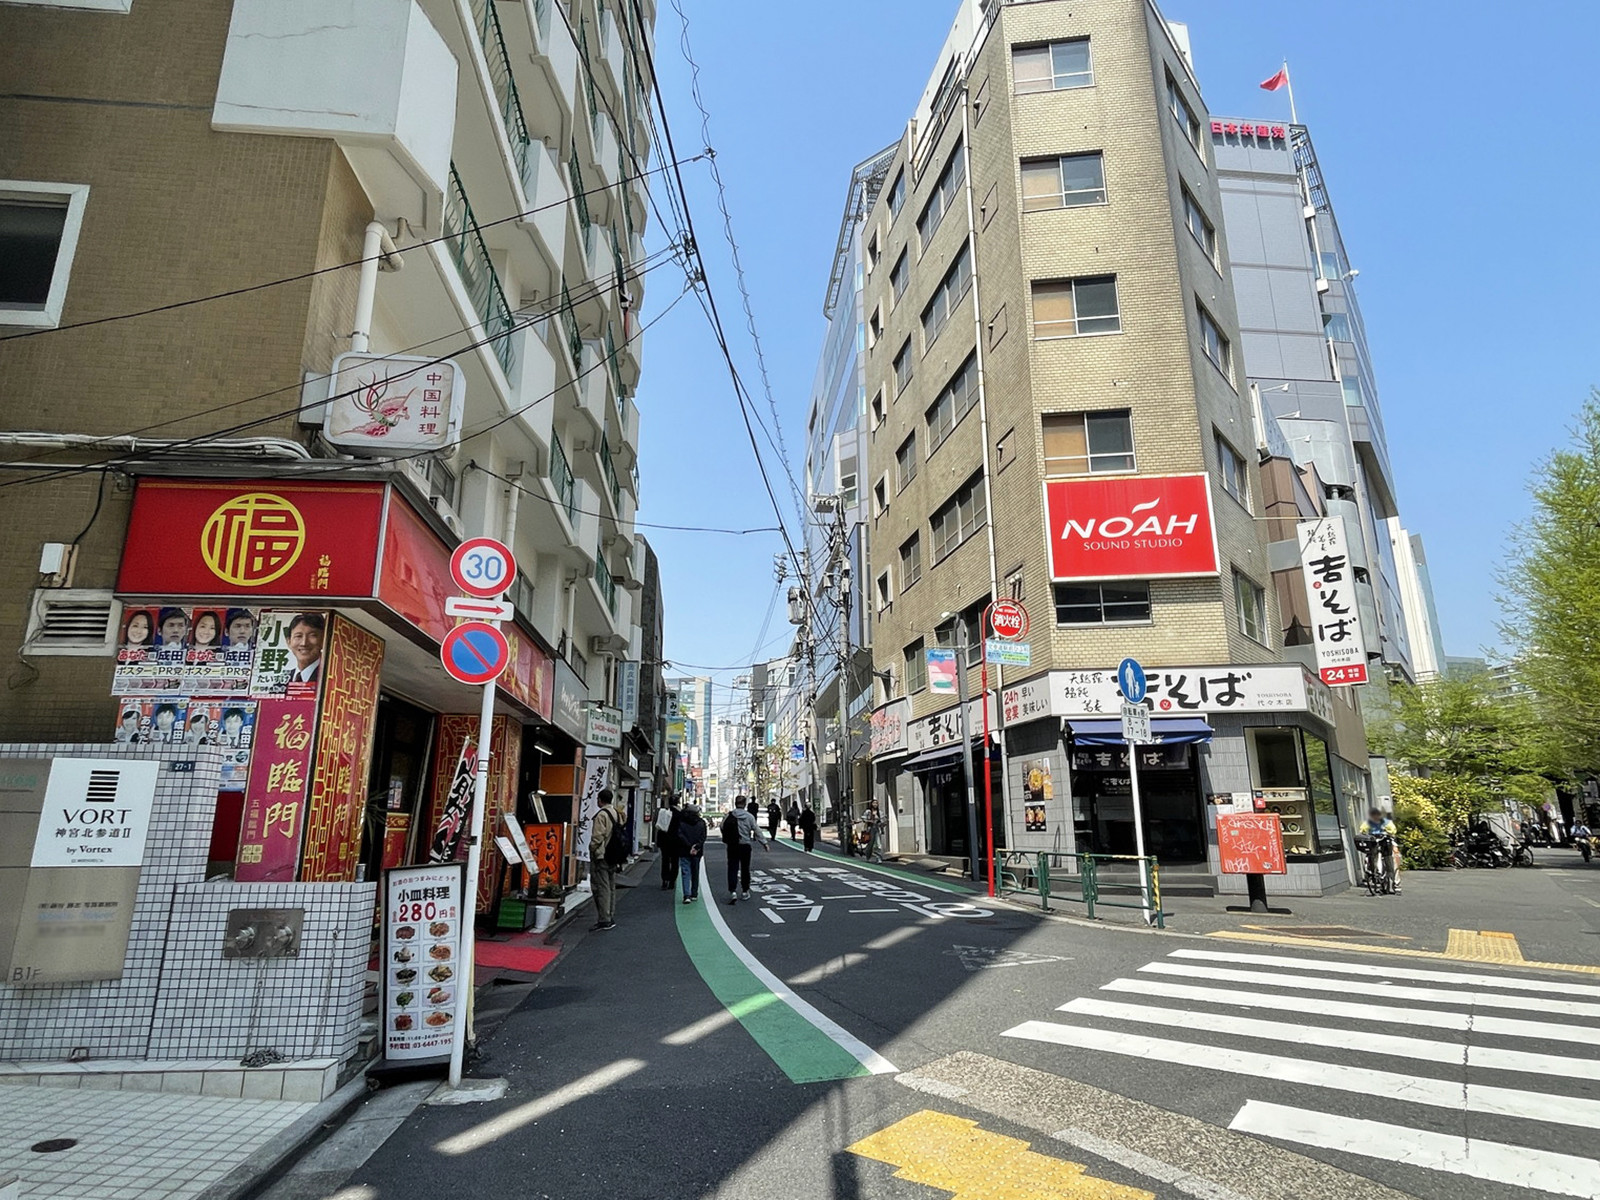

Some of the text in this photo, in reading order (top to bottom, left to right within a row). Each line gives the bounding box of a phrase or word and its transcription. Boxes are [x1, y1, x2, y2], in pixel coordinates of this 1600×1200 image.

[1211, 121, 1285, 138] 日本共産党
[418, 372, 442, 435] 中国料理
[1061, 514, 1198, 539] NOAH
[1083, 538, 1183, 551] SOUND STUDIO
[466, 553, 501, 581] 30
[1309, 554, 1357, 643] 吉そば
[994, 613, 1020, 628] 消火栓
[118, 649, 184, 661] あなた 成田
[259, 620, 290, 674] 小野
[1321, 647, 1359, 657] YOSHISOBA
[187, 650, 251, 661] あなた 成田
[116, 667, 152, 676] ポスター
[184, 667, 220, 676] ポスター
[257, 675, 290, 683] たいすけ
[1326, 668, 1345, 681] 24
[1004, 686, 1034, 705] 24h 早い
[1005, 699, 1048, 721] 営業 美味しい
[262, 714, 311, 839] 福臨門
[63, 808, 132, 824] VORT
[79, 845, 113, 853] Vortex
[398, 886, 450, 903] 小皿料理
[398, 902, 436, 922] 280
[439, 909, 448, 918] 円
[13, 967, 42, 982] B1F
